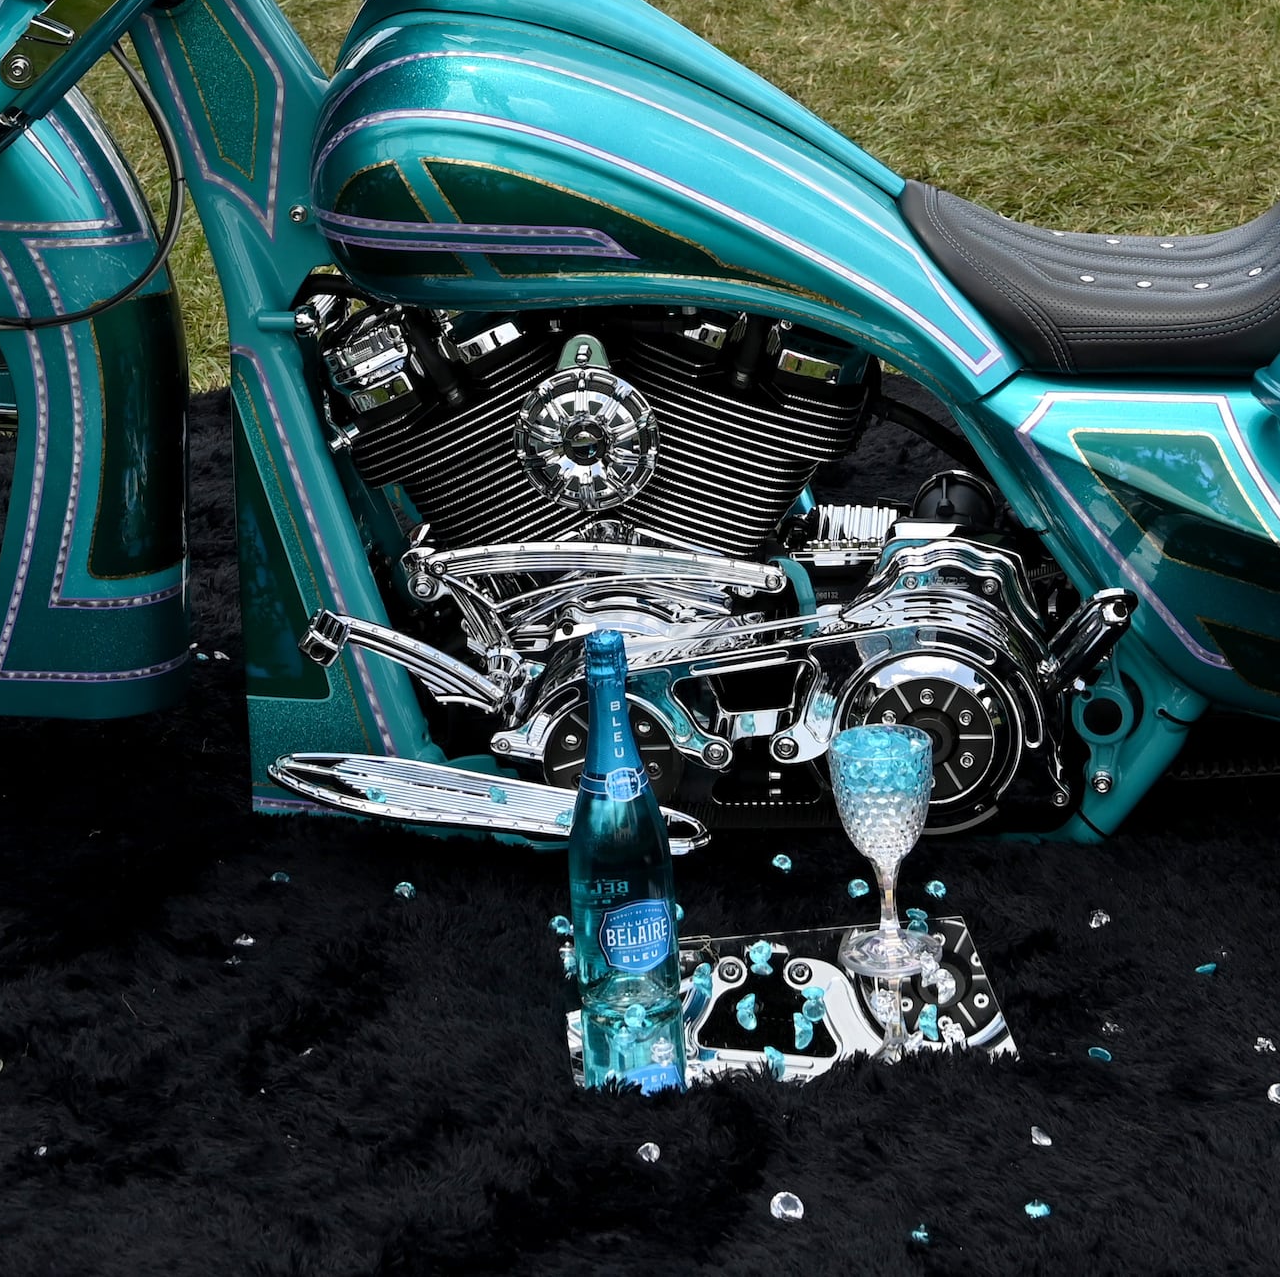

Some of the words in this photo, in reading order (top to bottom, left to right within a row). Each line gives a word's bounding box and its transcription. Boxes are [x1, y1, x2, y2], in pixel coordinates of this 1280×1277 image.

[610, 700, 625, 758] BLEU
[605, 917, 668, 947] BELAIRE
[622, 949, 659, 963] BLEU
